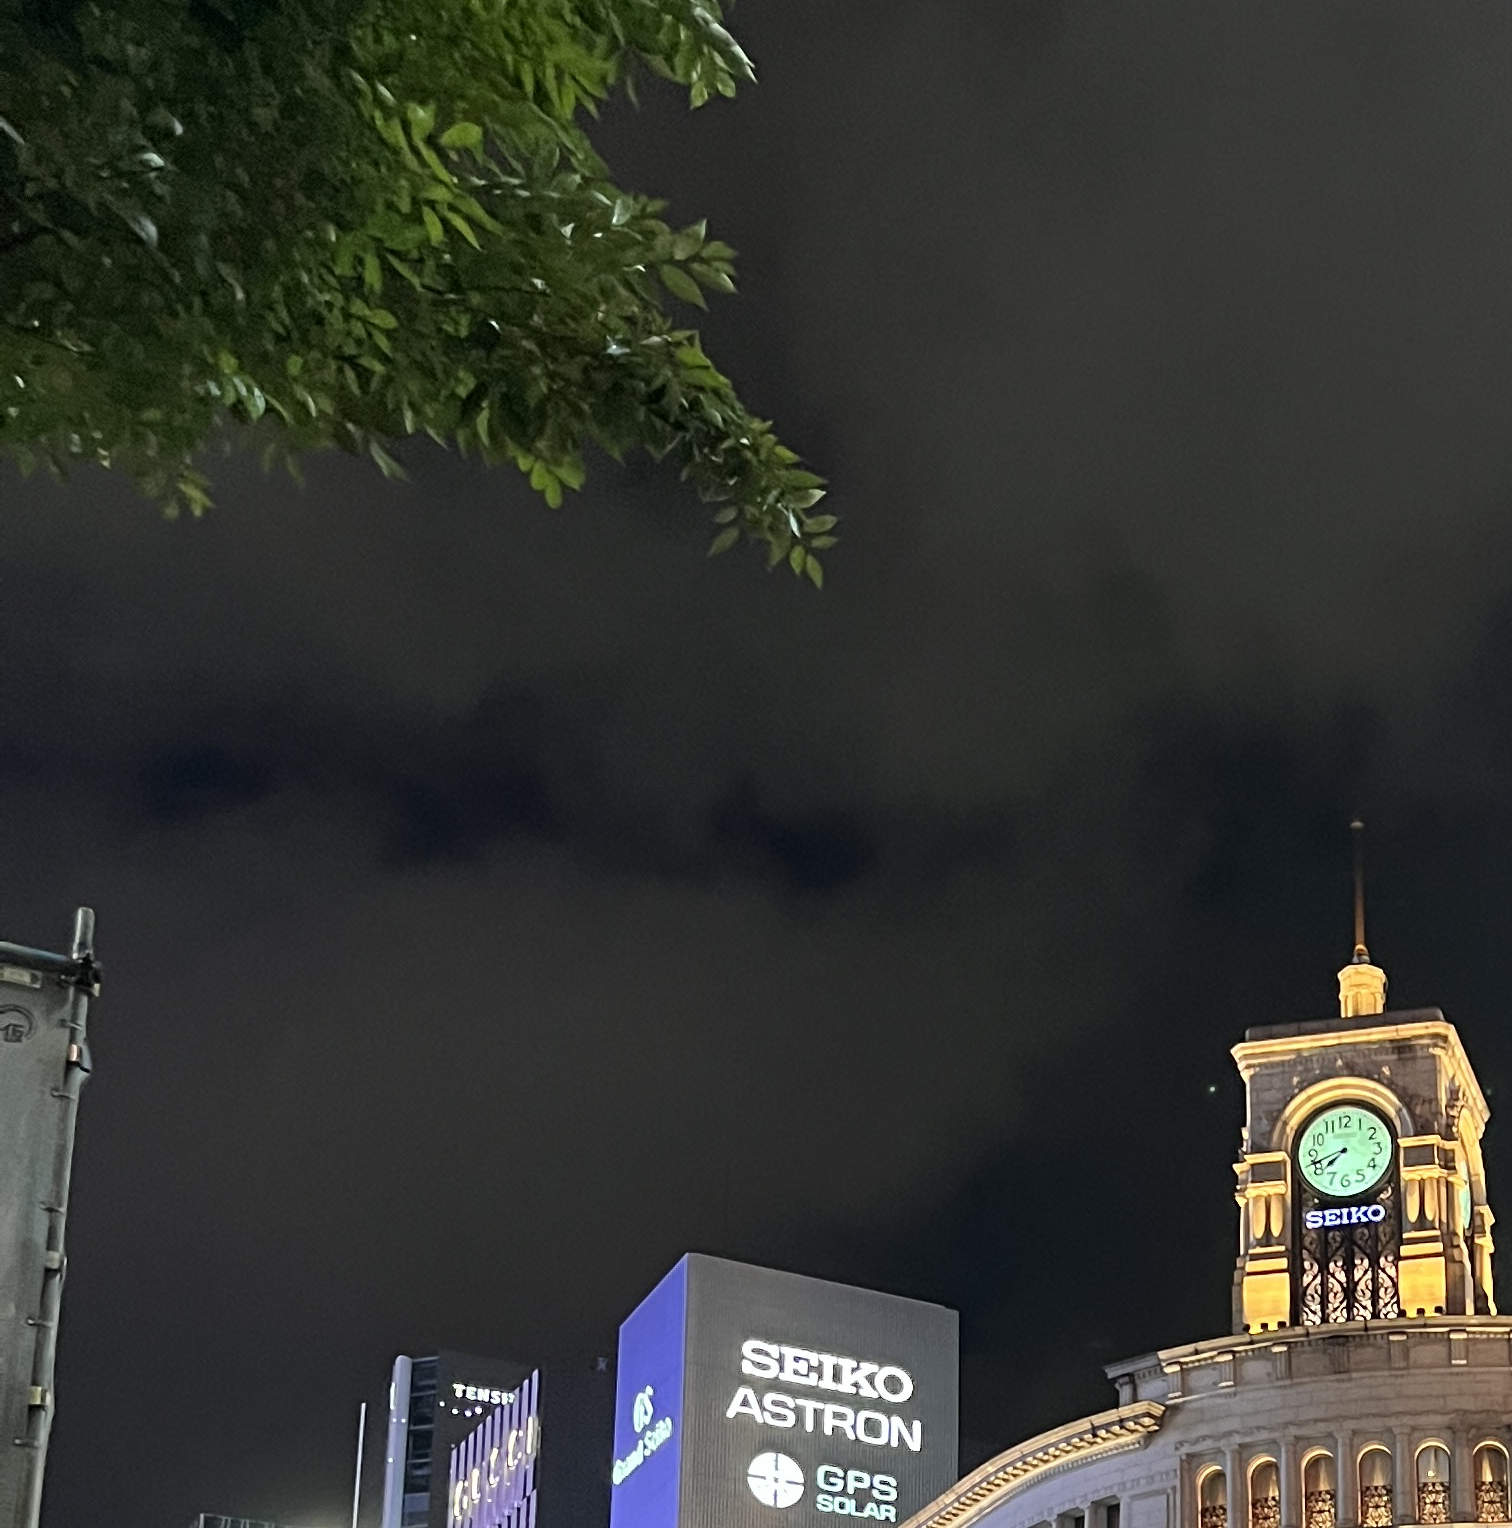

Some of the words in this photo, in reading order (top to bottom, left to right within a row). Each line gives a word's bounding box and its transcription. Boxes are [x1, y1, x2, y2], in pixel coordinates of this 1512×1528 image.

[1324, 1119, 1334, 1134] 11
[1338, 1115, 1352, 1129] 12
[1312, 1132, 1325, 1147] 10
[1367, 1126, 1377, 1140] 2
[1308, 1148, 1318, 1162] 9
[1373, 1141, 1383, 1155] 3
[1313, 1161, 1324, 1176] 8
[1366, 1157, 1377, 1169] 4
[1326, 1171, 1338, 1186] 7
[1340, 1173, 1351, 1188] 6
[1354, 1168, 1366, 1183] 5
[1305, 1203, 1386, 1229] SEIKO
[741, 1339, 914, 1403] SEIKO
[725, 1386, 923, 1452] ASTRON
[816, 1464, 898, 1501] GPS
[815, 1494, 897, 1523] SOLAR
